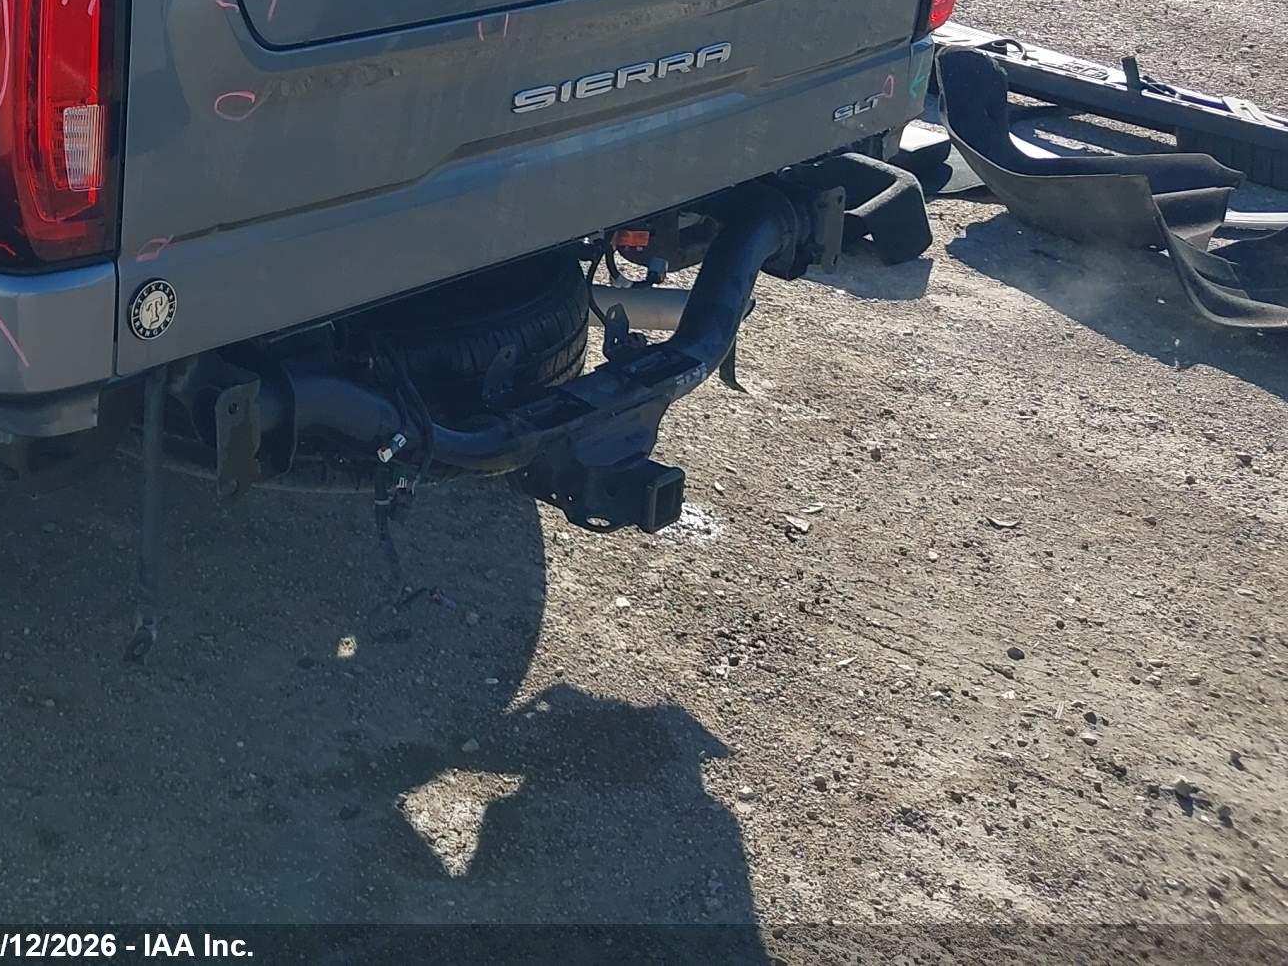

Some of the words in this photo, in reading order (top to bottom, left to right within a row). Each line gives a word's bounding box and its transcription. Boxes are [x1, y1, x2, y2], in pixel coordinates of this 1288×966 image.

[512, 40, 732, 113] SIERRA
[831, 91, 885, 122] SLT
[138, 283, 170, 304] TEXAS
